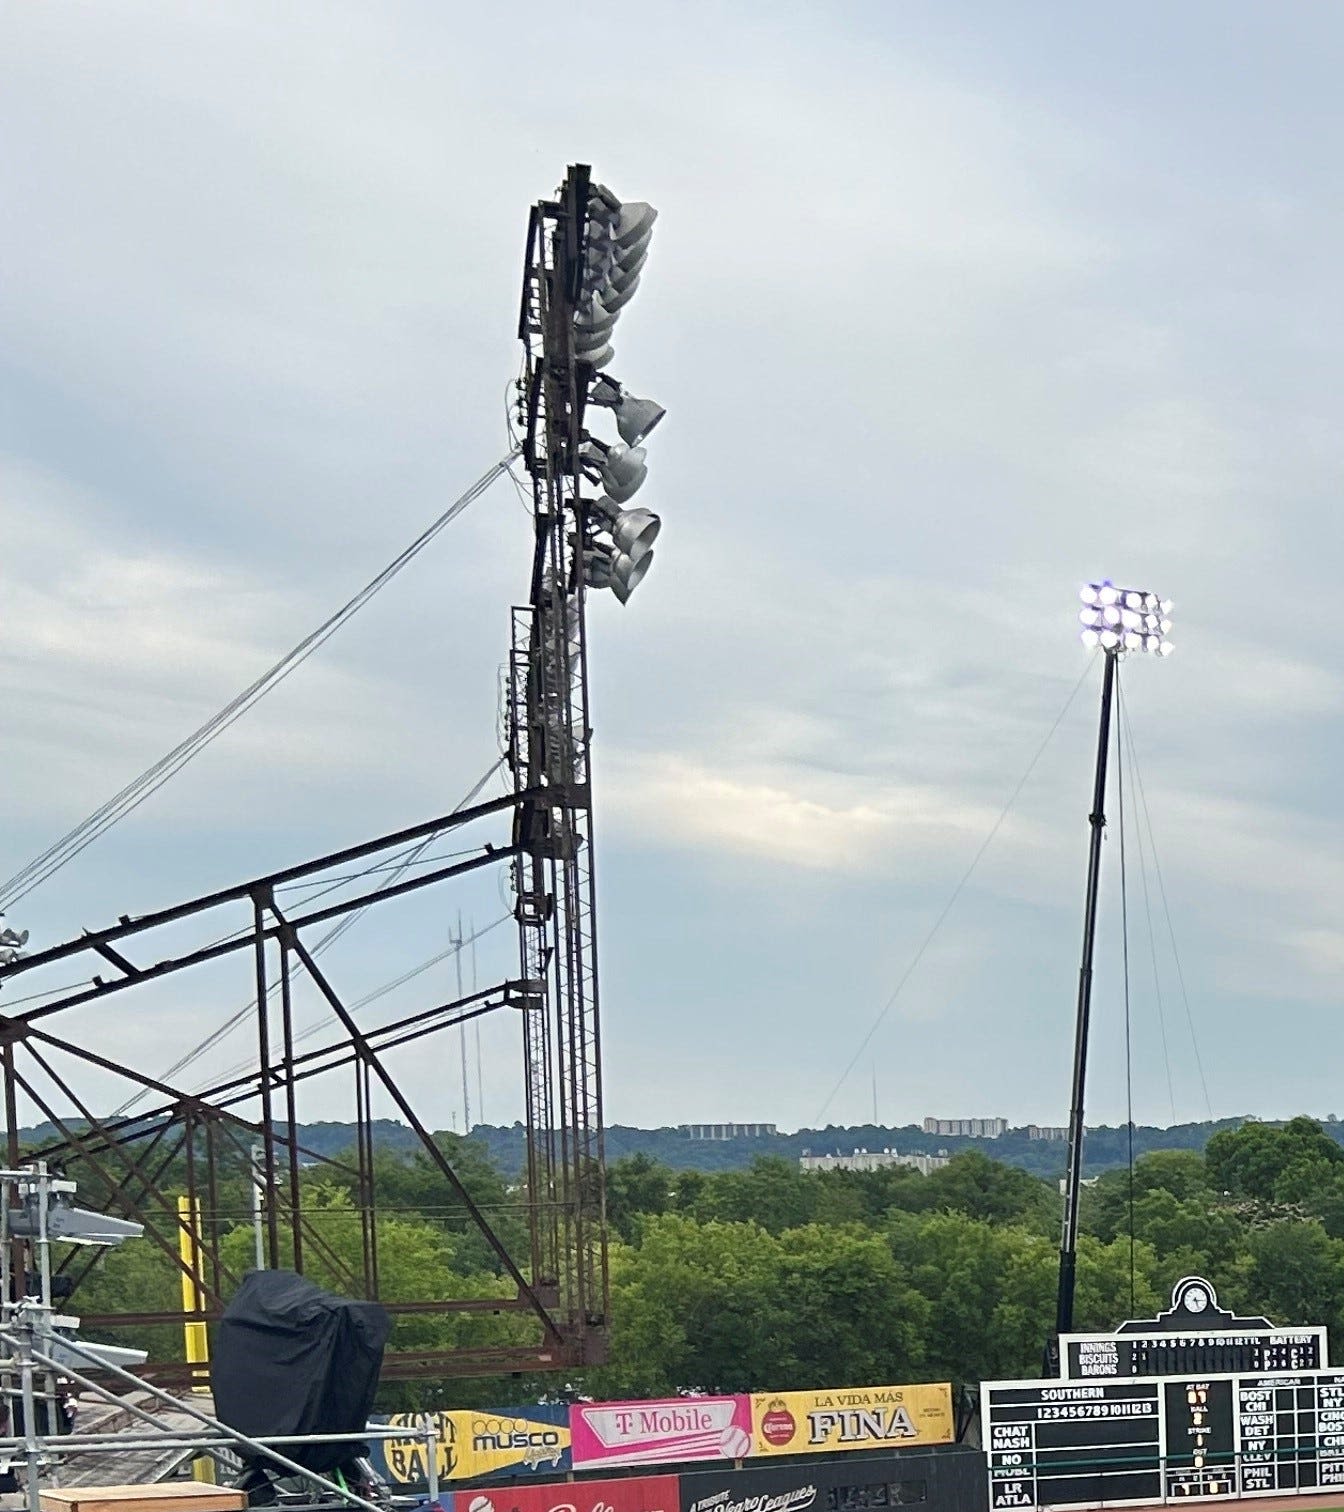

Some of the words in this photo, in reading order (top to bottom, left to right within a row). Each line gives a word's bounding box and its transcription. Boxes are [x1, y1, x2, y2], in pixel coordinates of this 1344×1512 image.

[1078, 1353, 1119, 1365] BISCUITS
[1081, 1364, 1118, 1375] BARONS
[1257, 1378, 1301, 1387] AMERICAN
[1041, 1388, 1104, 1401] SOUTHERN
[1240, 1391, 1272, 1402] BOST
[814, 1397, 834, 1408] LA
[837, 1394, 872, 1407] VIDA
[1245, 1401, 1267, 1411] CHI
[1322, 1398, 1343, 1408] NY
[639, 1409, 712, 1434] Mobile
[807, 1406, 919, 1445] FINA
[1240, 1414, 1274, 1426] WASH
[993, 1425, 1028, 1438] CHAT
[1244, 1426, 1270, 1437] DET
[993, 1437, 1030, 1449] NASH
[1248, 1441, 1266, 1451] NY
[1323, 1436, 1344, 1447] CHI
[1001, 1454, 1022, 1466] NO
[1243, 1468, 1273, 1479] PHIL
[1004, 1483, 1022, 1494] LR
[1245, 1479, 1271, 1489] STL
[995, 1494, 1032, 1506] ATLA
